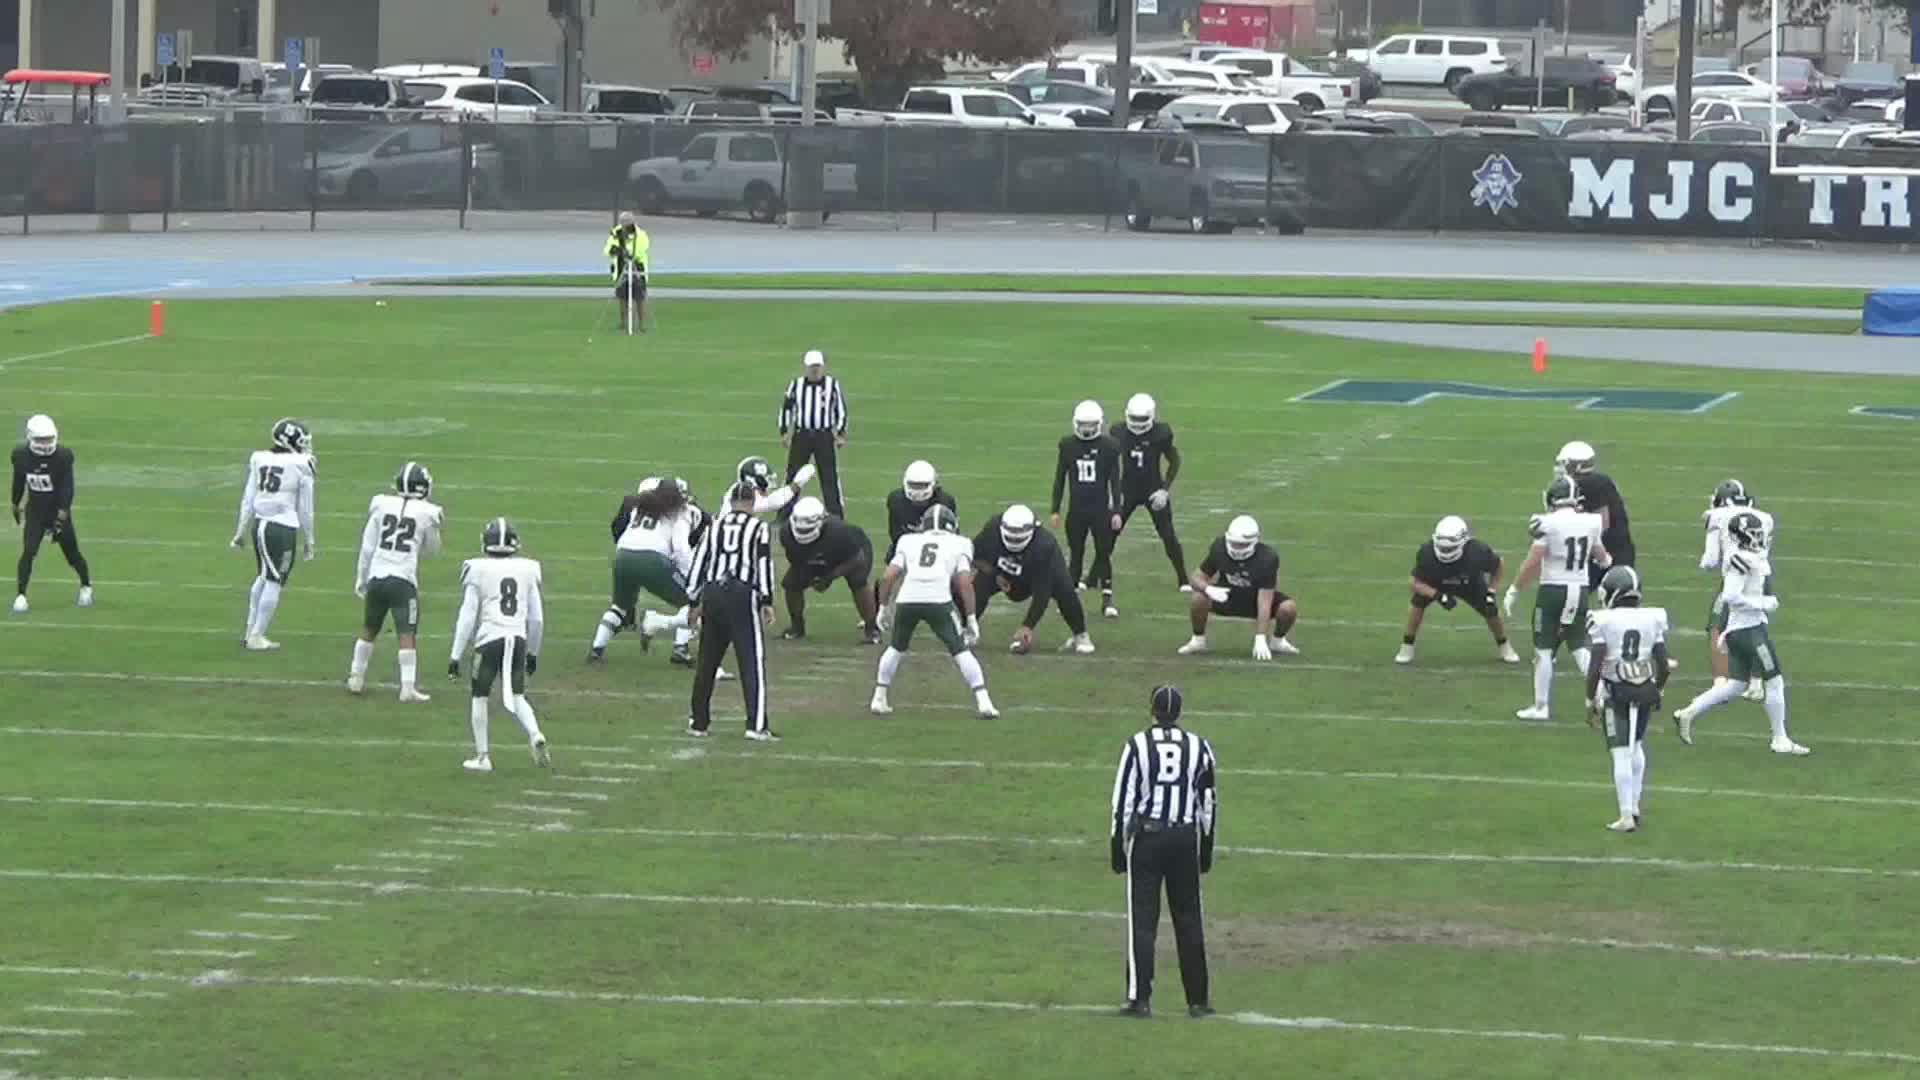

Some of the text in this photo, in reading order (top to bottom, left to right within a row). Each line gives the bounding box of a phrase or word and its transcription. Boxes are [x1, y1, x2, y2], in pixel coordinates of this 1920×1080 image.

[1568, 157, 1754, 222] MJC
[1076, 459, 1096, 482] 10
[1131, 450, 1143, 467] 7
[259, 465, 284, 493] 15
[379, 513, 416, 552] 22
[919, 542, 939, 567] 6
[1564, 536, 1588, 571] 11
[500, 577, 518, 617] 8
[1622, 629, 1641, 662] 0
[1155, 742, 1182, 782] B
